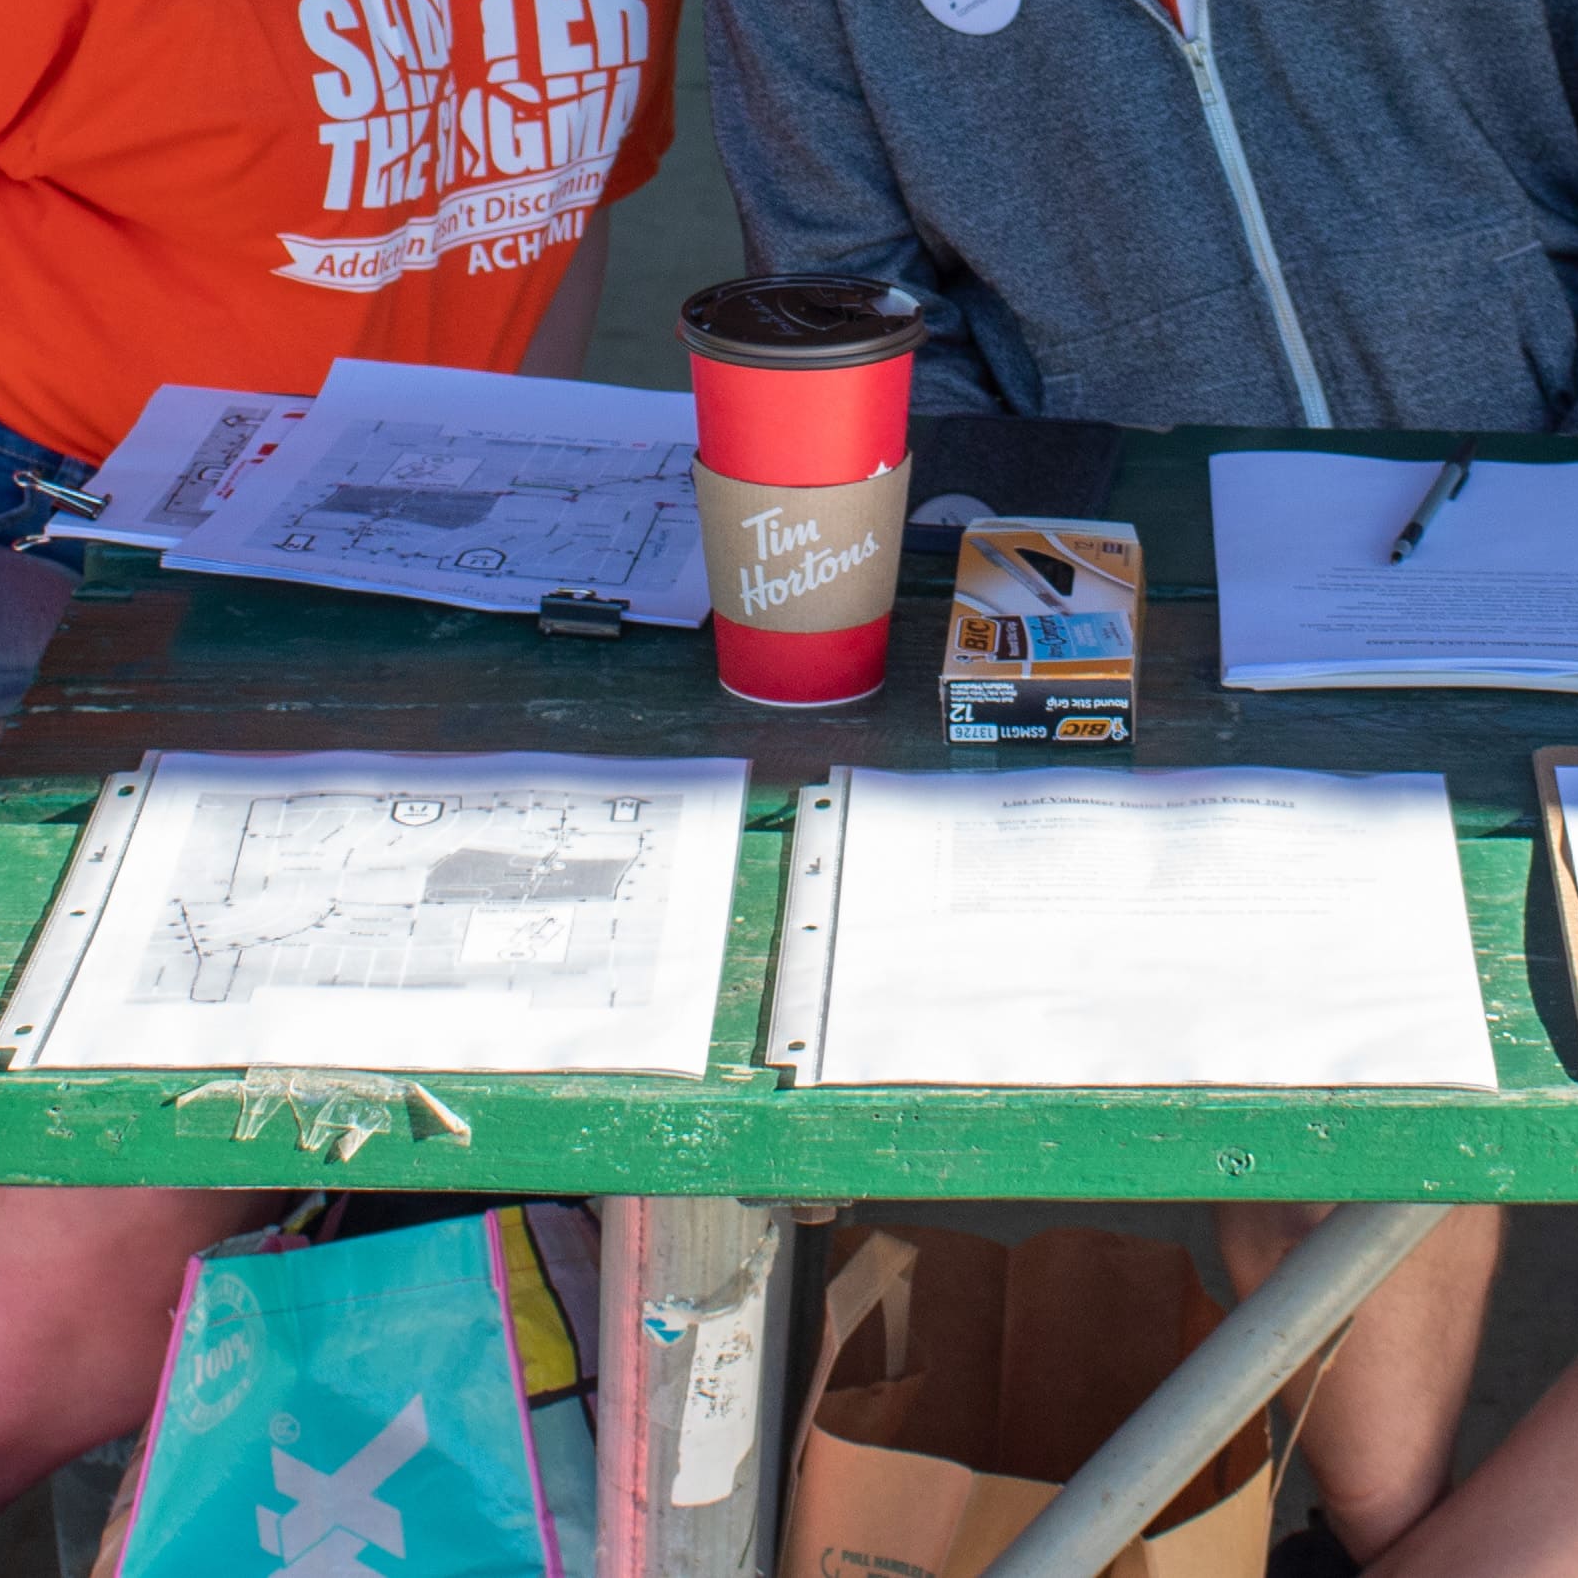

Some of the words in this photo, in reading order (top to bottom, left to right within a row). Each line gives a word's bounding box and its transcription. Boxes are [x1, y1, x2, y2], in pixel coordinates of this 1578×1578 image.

[740, 506, 822, 561] Tim
[739, 531, 880, 616] Hortons
[1071, 697, 1092, 709] Stic
[1093, 698, 1129, 709] Round
[950, 703, 975, 722] 12
[954, 727, 994, 739] 13726
[1000, 725, 1048, 739] GSMG11
